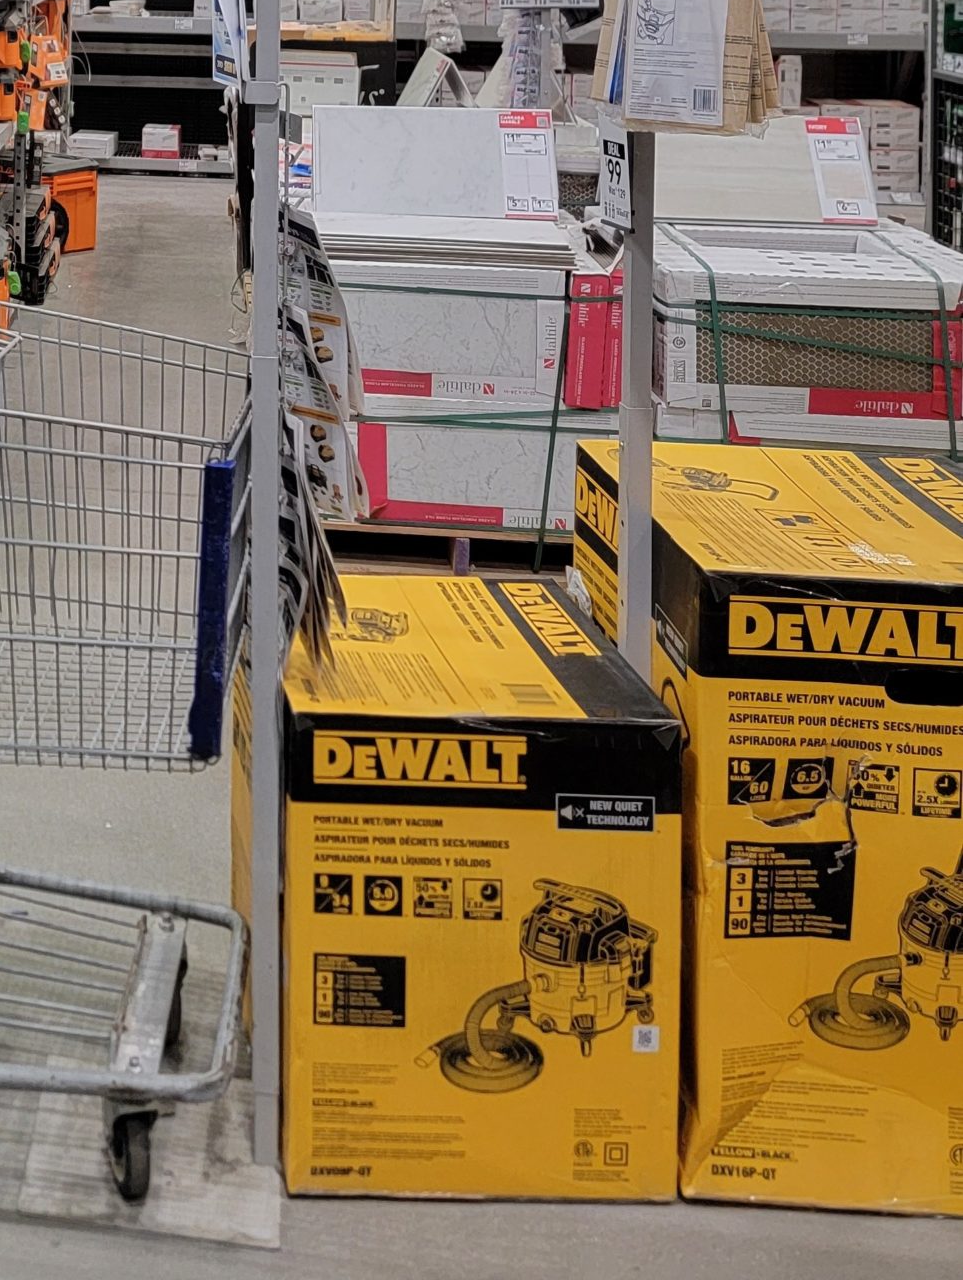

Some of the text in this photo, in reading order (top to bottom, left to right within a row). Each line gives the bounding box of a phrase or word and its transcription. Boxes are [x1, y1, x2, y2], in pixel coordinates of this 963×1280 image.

[607, 142, 620, 157] DEAL
[545, 316, 557, 357] daltile
[438, 380, 481, 394] daltile
[728, 691, 885, 708] PORTABLE WET/DRY VACUUM
[728, 713, 963, 735] ASPIRATEUR POUR DÉCHETS SECS/HUMIDES
[728, 735, 796, 747] ASPIRADORA
[800, 737, 827, 747] PARA
[886, 743, 893, 753] Y
[896, 743, 943, 757] SÓLIDOS
[731, 760, 750, 774] 16
[796, 770, 819, 783] 6.5
[749, 782, 769, 795] 60
[867, 783, 895, 791] QUIETER
[851, 798, 897, 810] POWERFUL
[875, 793, 897, 802] MORE
[917, 795, 938, 804] 2.5X
[590, 801, 643, 812] NEW QUIET
[313, 815, 443, 828] PORTABLE WET/DRY VACUUM
[586, 815, 649, 826] TECHNOLOGY
[314, 834, 510, 849] ASPIRATEUR POUR DÉCHETS SECS/HUMIDES
[314, 854, 491, 868] ASPIRADORA PARA LÍQUIDOS Y SÓLIDOS
[736, 873, 746, 884] 3
[736, 896, 743, 907] 1
[731, 918, 748, 930] 90
[711, 1165, 776, 1180] DXV16P-QT
